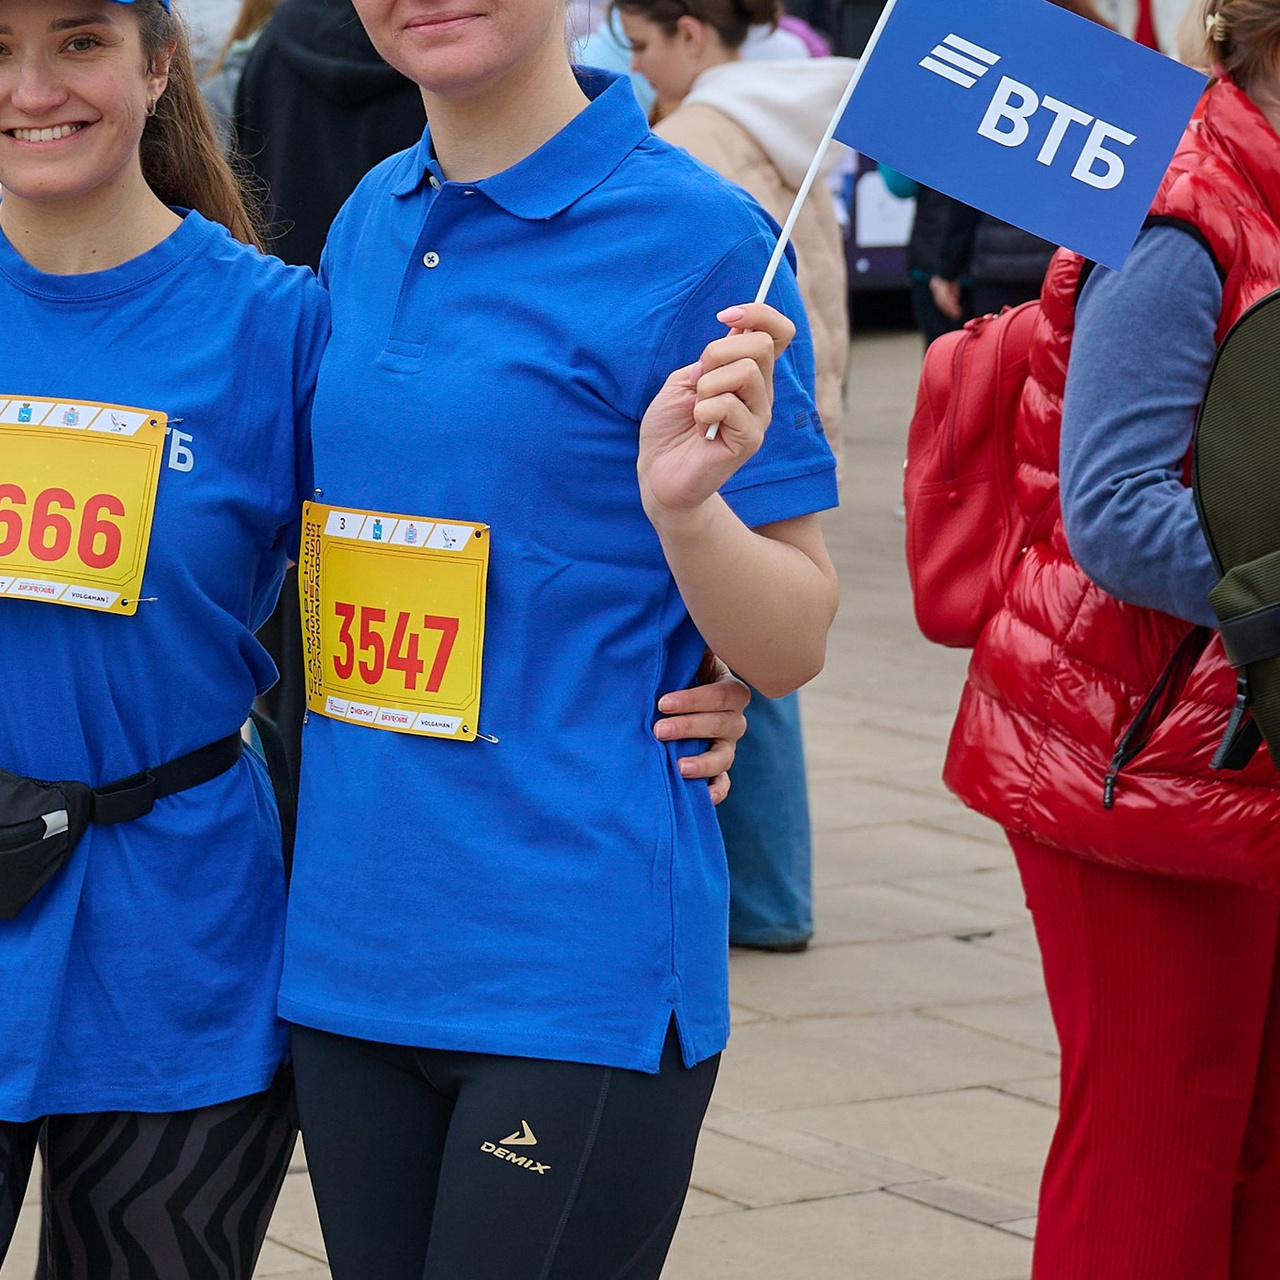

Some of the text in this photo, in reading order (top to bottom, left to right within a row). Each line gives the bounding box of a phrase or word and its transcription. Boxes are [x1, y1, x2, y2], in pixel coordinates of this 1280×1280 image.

[977, 75, 1137, 190] ВТБ
[165, 427, 194, 472] Б
[339, 517, 346, 530] 3
[333, 601, 460, 693] 3547
[480, 1141, 551, 1175] DEMIX
